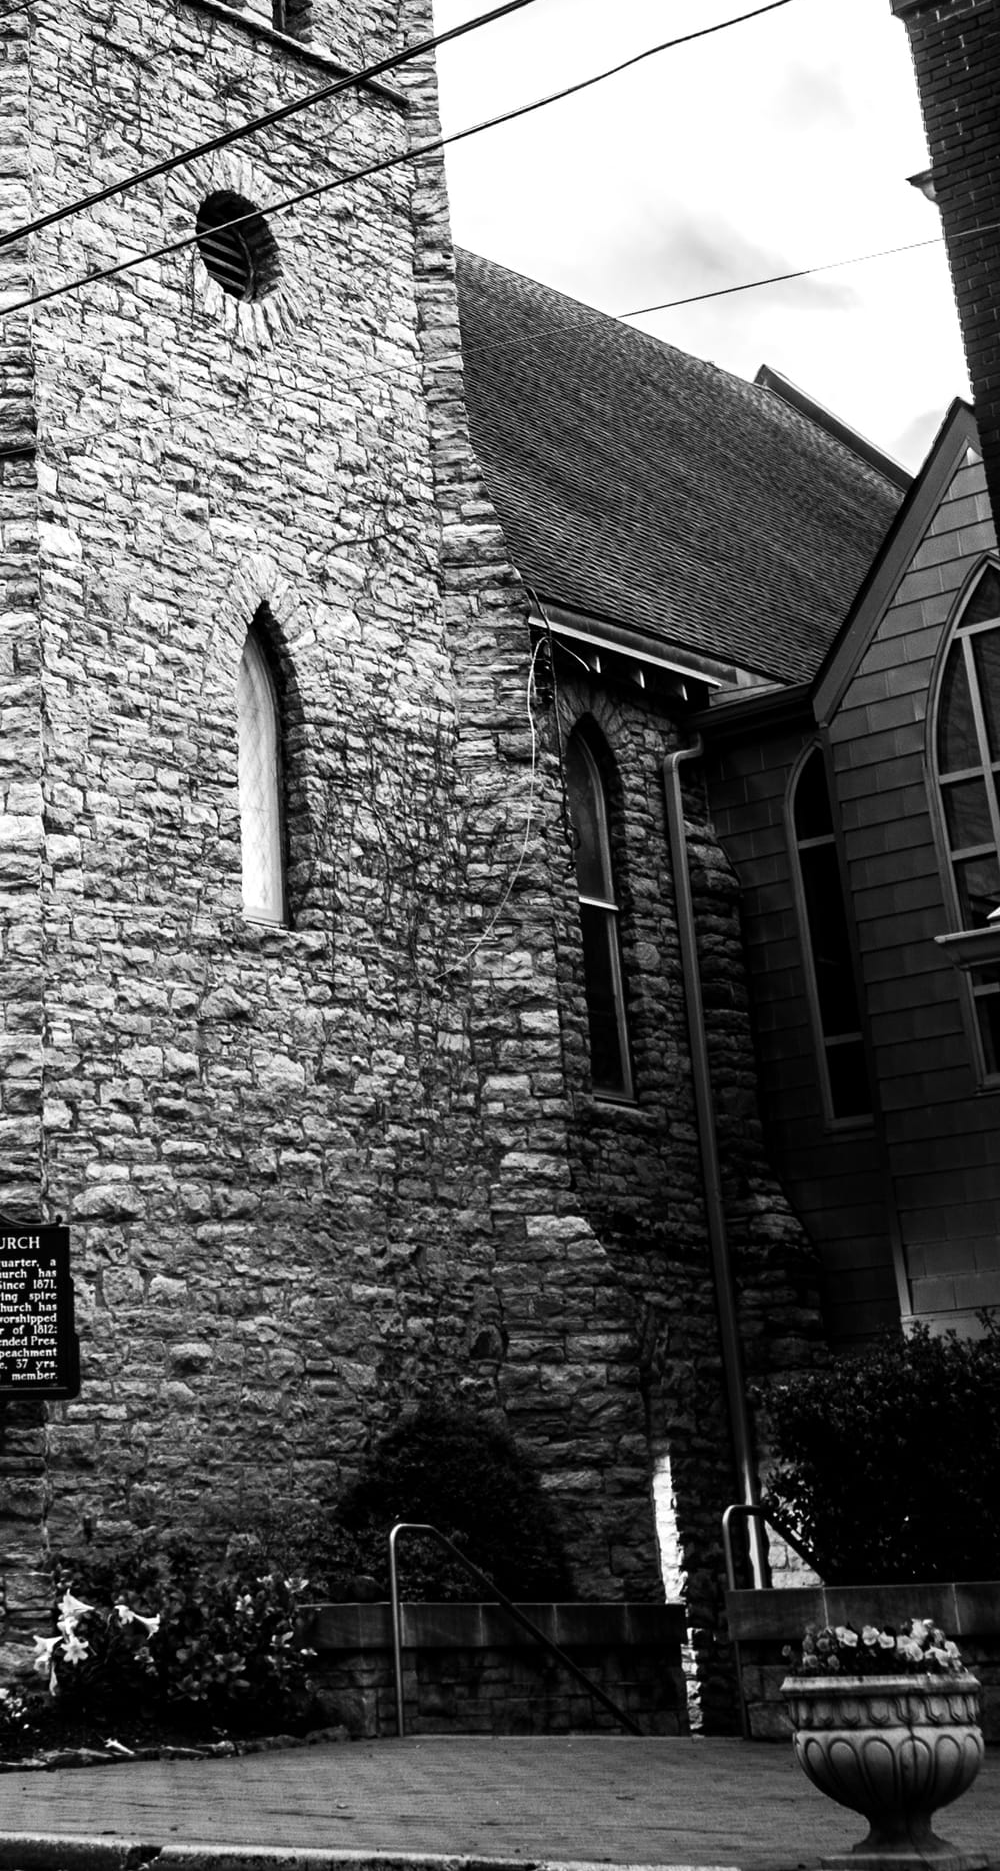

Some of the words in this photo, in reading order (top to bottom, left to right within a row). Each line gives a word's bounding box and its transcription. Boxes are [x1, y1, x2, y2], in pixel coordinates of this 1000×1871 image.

[49, 1258, 57, 1267] a
[37, 1268, 57, 1278] has
[28, 1291, 58, 1302] spire
[37, 1301, 58, 1311] has
[11, 1323, 26, 1336] of
[30, 1335, 58, 1346] Pres.
[15, 1357, 29, 1369] 37
[35, 1361, 58, 1371] yrs.
[11, 1370, 58, 1380] member.
